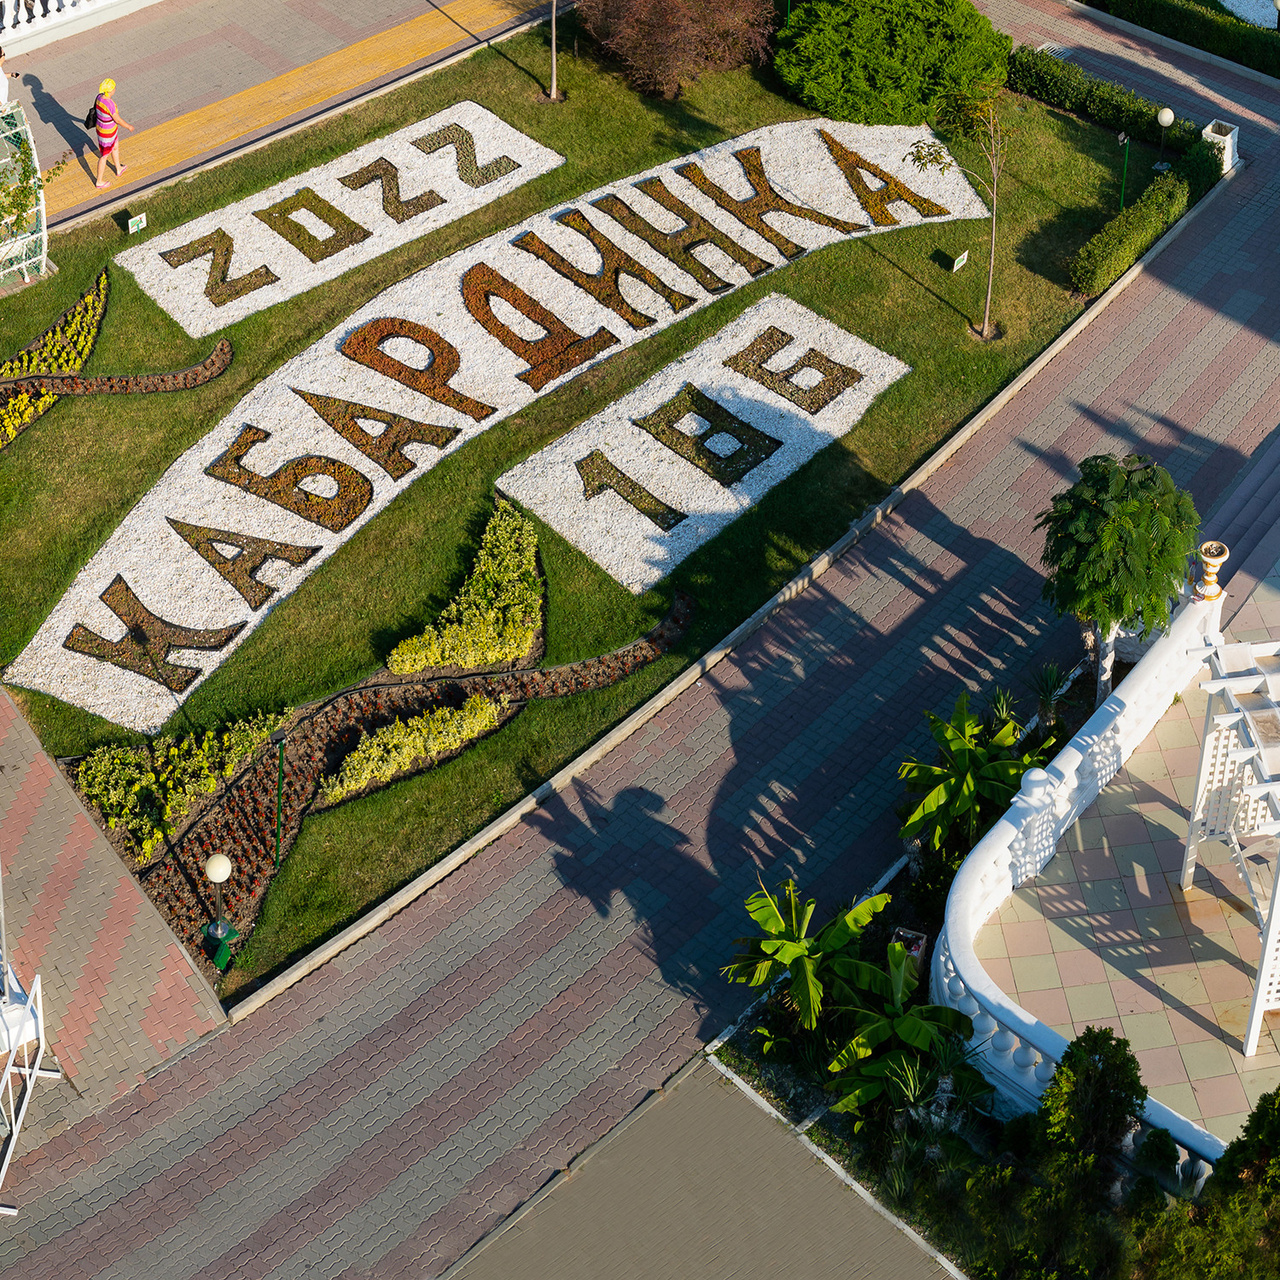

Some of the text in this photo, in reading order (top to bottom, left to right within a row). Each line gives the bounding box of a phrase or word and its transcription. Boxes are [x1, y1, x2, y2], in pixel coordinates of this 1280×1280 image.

[158, 121, 523, 308] 2022
[61, 127, 952, 694] КАБАРДИНКА
[573, 324, 863, 533] 186
